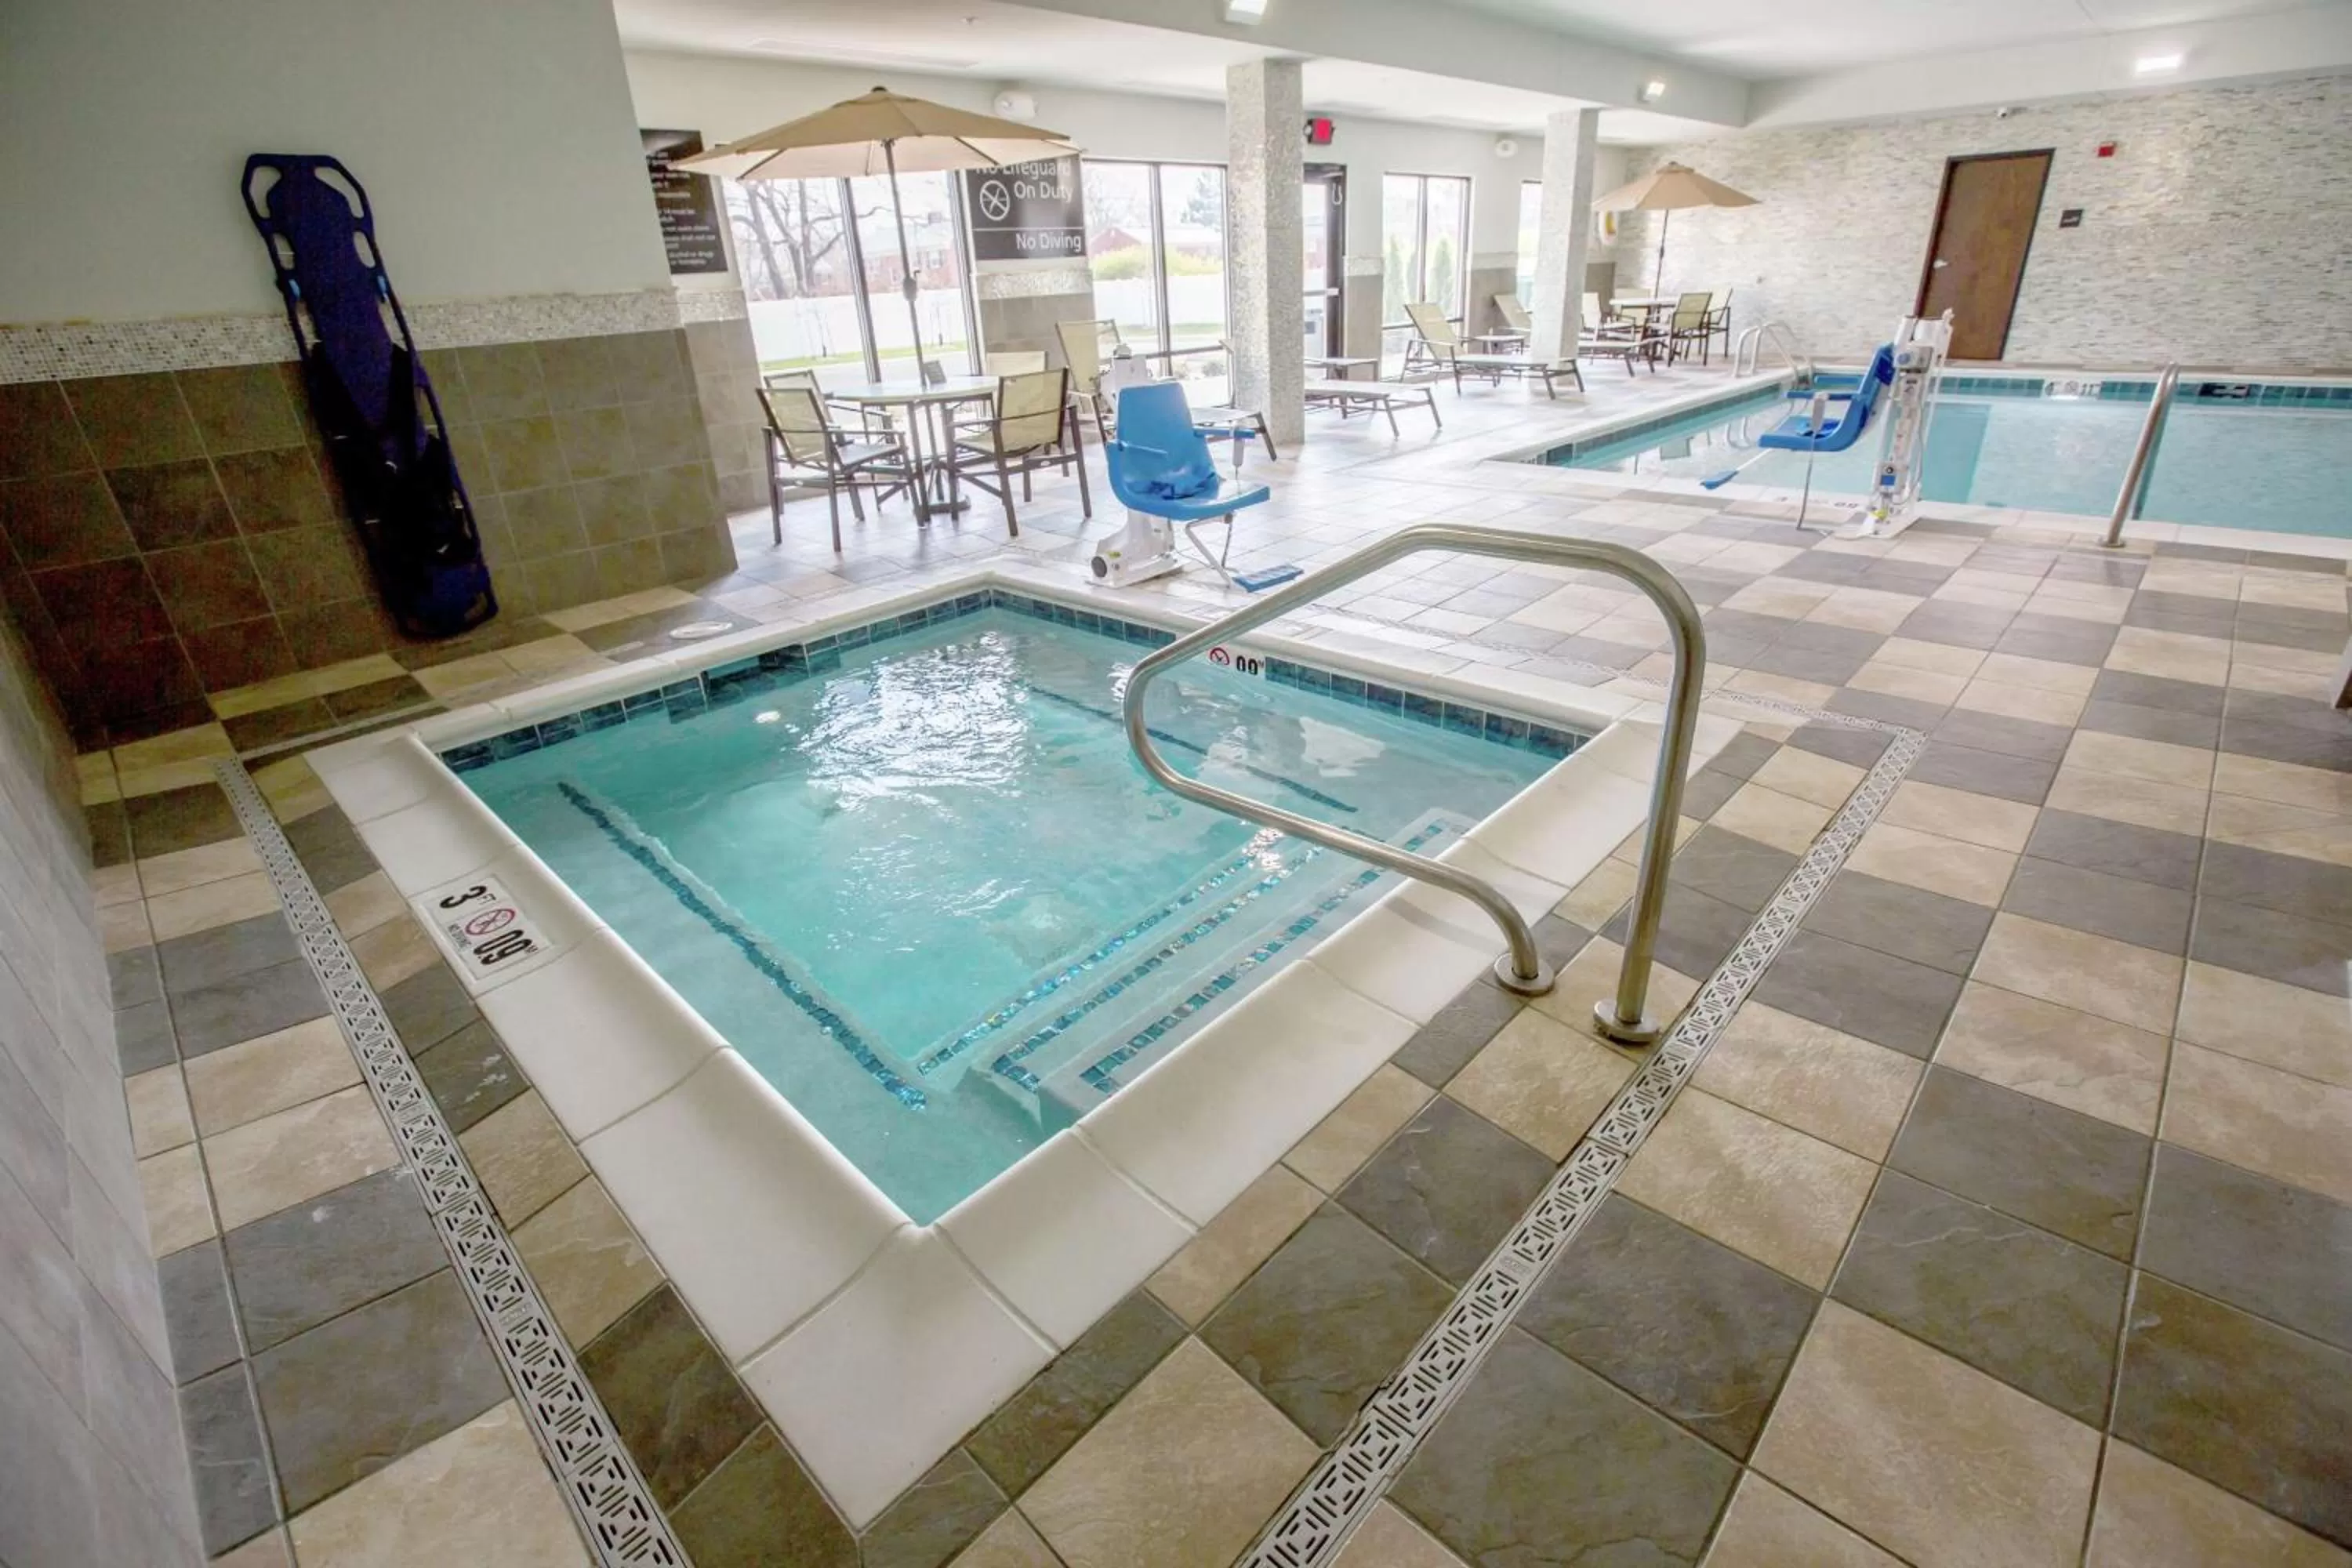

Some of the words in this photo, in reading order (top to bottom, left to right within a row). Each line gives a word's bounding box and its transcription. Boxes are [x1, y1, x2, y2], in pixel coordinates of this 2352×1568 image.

[1014, 180, 1036, 198] On
[1040, 181, 1073, 204] Duty
[1015, 233, 1036, 250] No
[1040, 232, 1080, 252] Diving
[440, 885, 487, 908] 3
